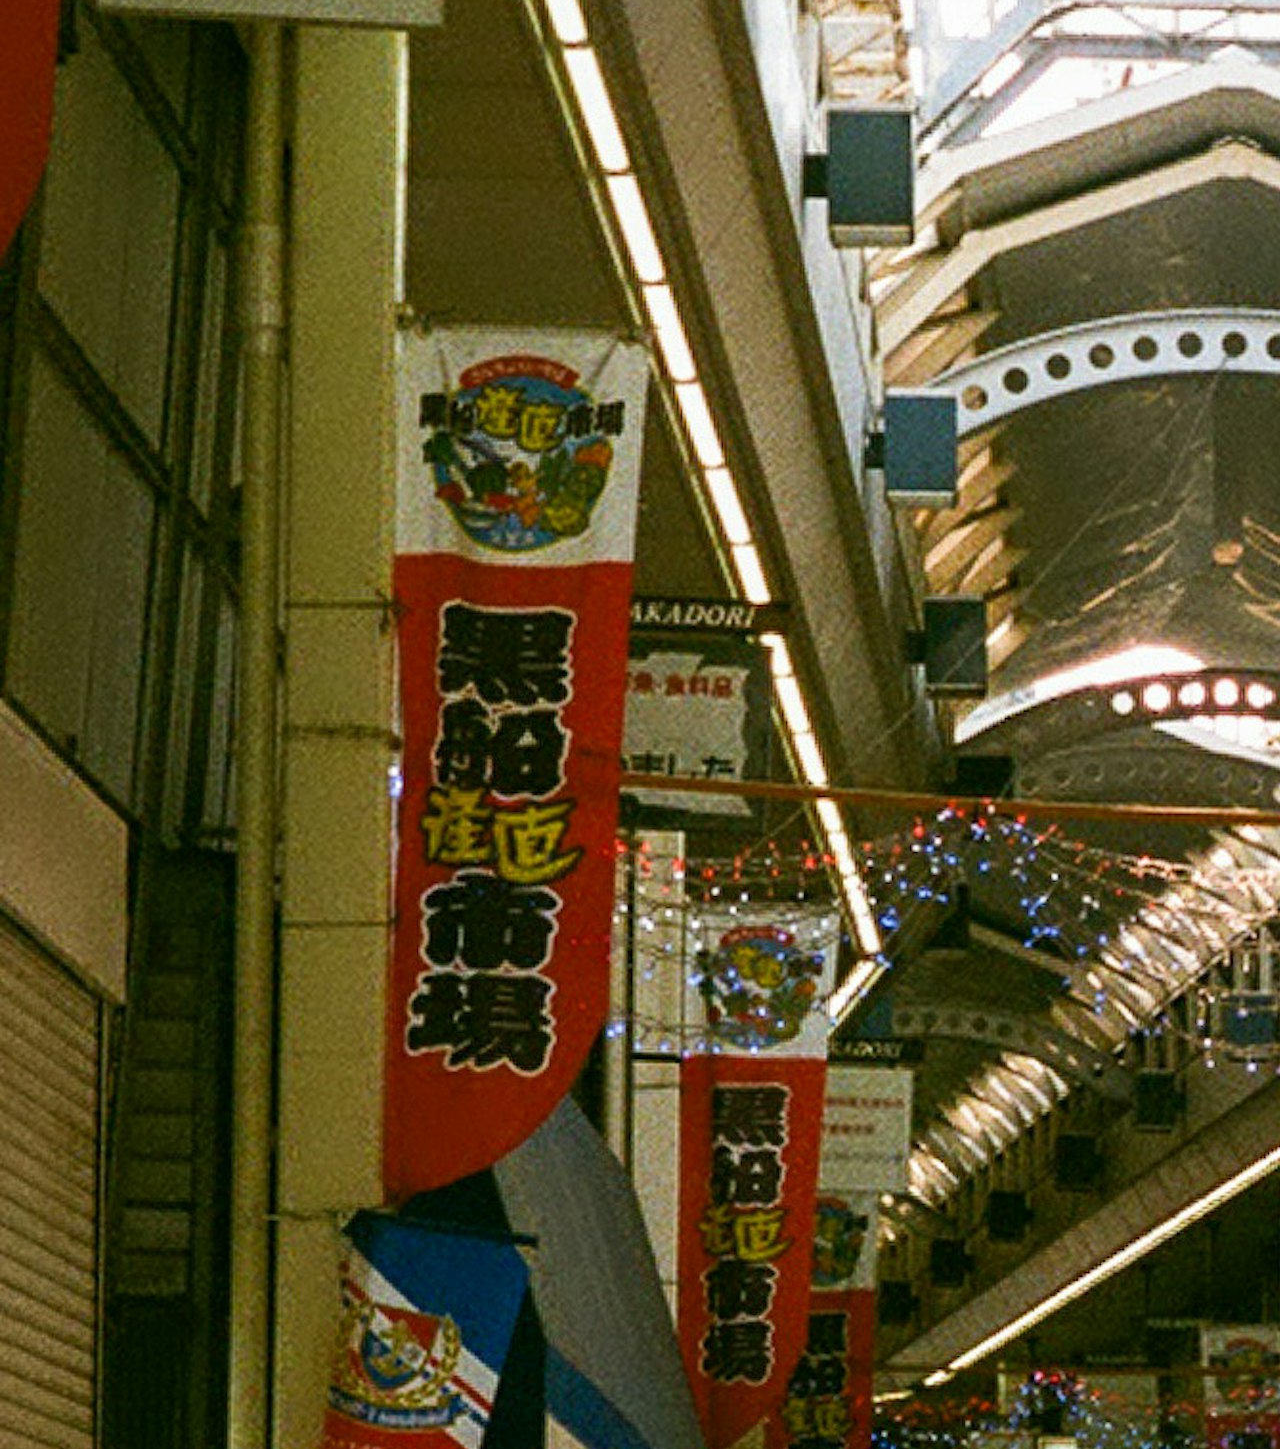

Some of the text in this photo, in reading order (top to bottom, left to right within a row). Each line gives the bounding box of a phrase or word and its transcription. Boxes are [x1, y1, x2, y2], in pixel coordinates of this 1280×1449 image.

[405, 600, 583, 1078] 黒船産直市場
